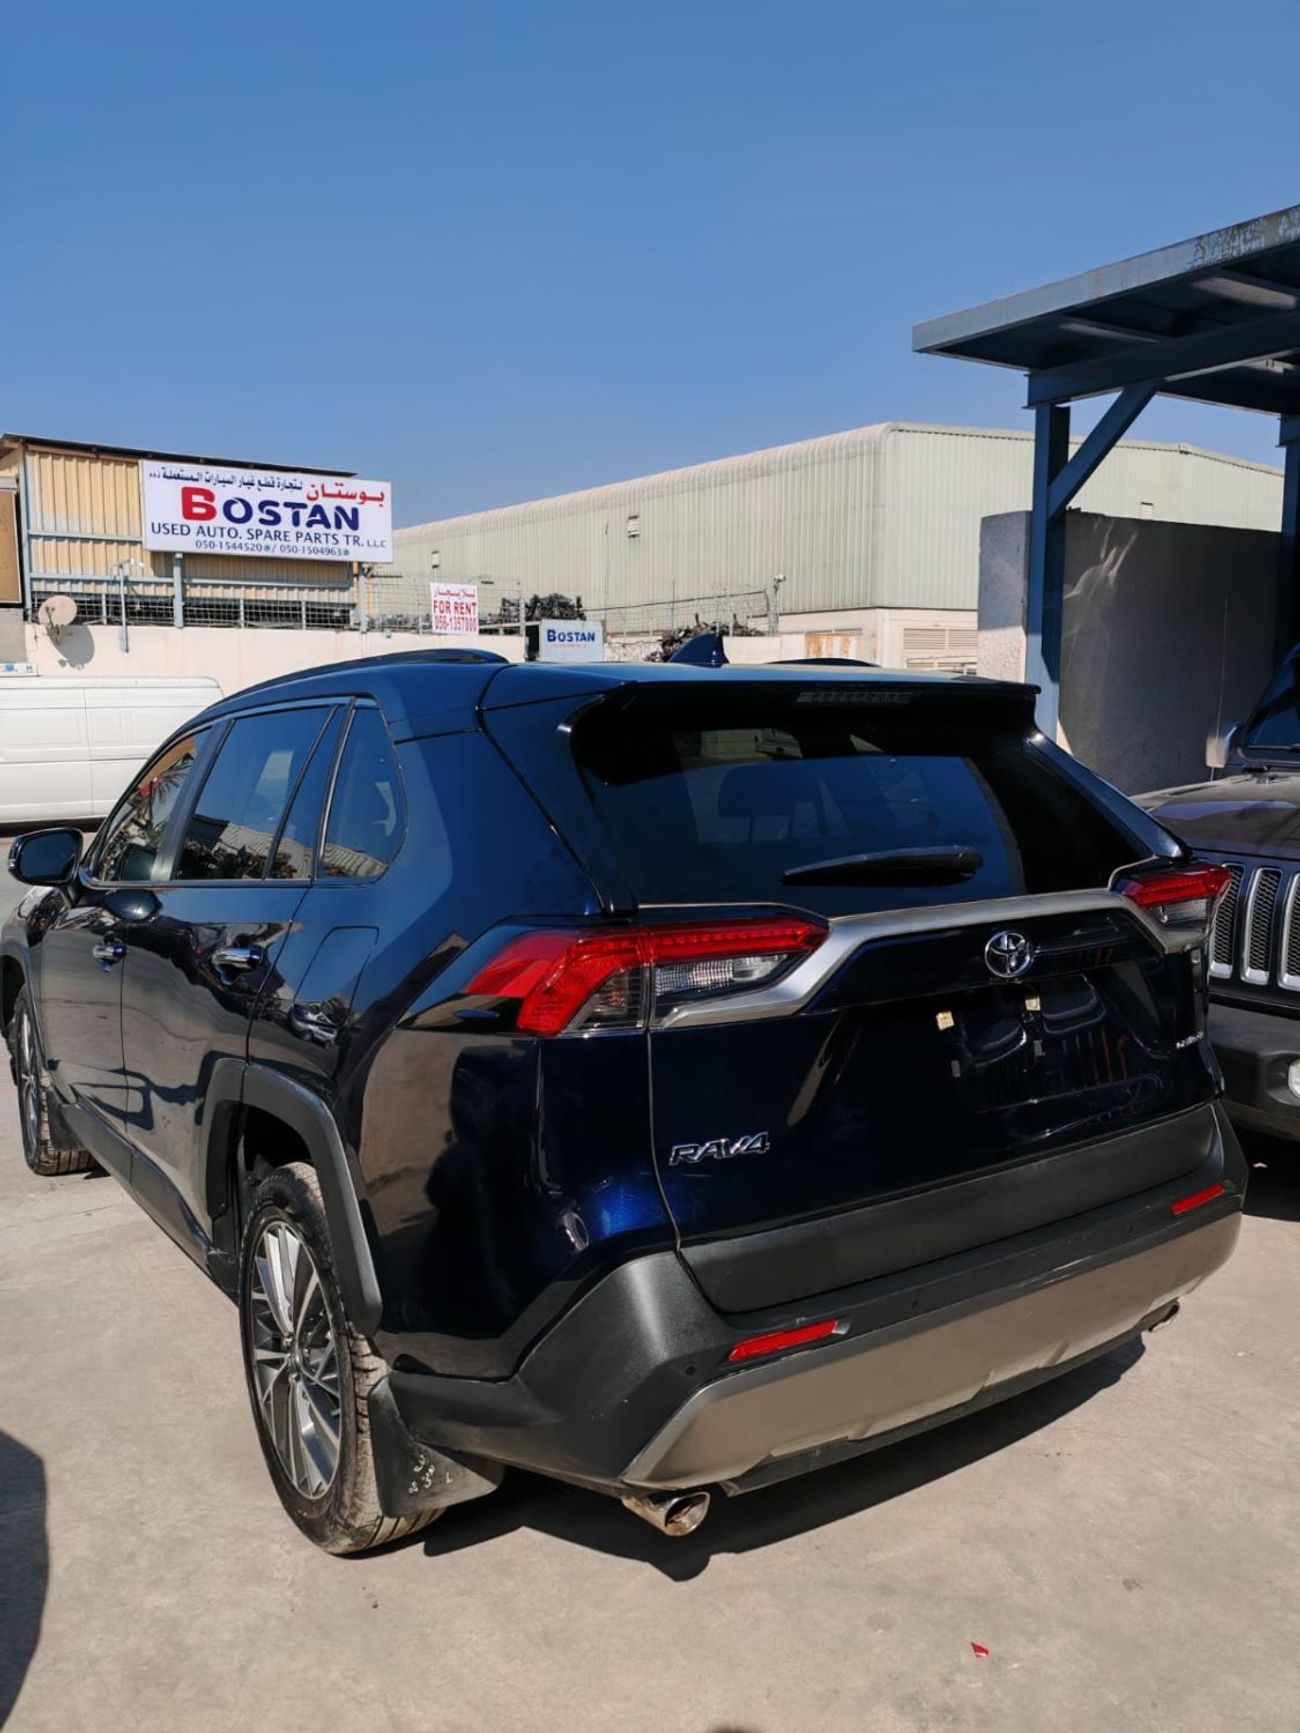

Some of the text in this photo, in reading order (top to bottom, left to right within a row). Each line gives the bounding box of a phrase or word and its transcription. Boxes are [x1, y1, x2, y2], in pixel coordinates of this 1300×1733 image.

[161, 466, 203, 481] المستعملة
[204, 470, 237, 487] السيارات
[238, 474, 255, 489] غيار
[257, 475, 275, 492] قطع
[277, 477, 303, 492] لتجارة
[306, 481, 385, 508] بوستان
[181, 487, 360, 531] BOSTAN
[151, 522, 191, 536] USED
[196, 525, 242, 539] AUTO.
[247, 528, 291, 542] SPARE
[295, 531, 339, 546] PARTS
[433, 600, 477, 615] FOR RENT
[547, 629, 596, 642] BOSTAN
[668, 1131, 770, 1166] RAV4
